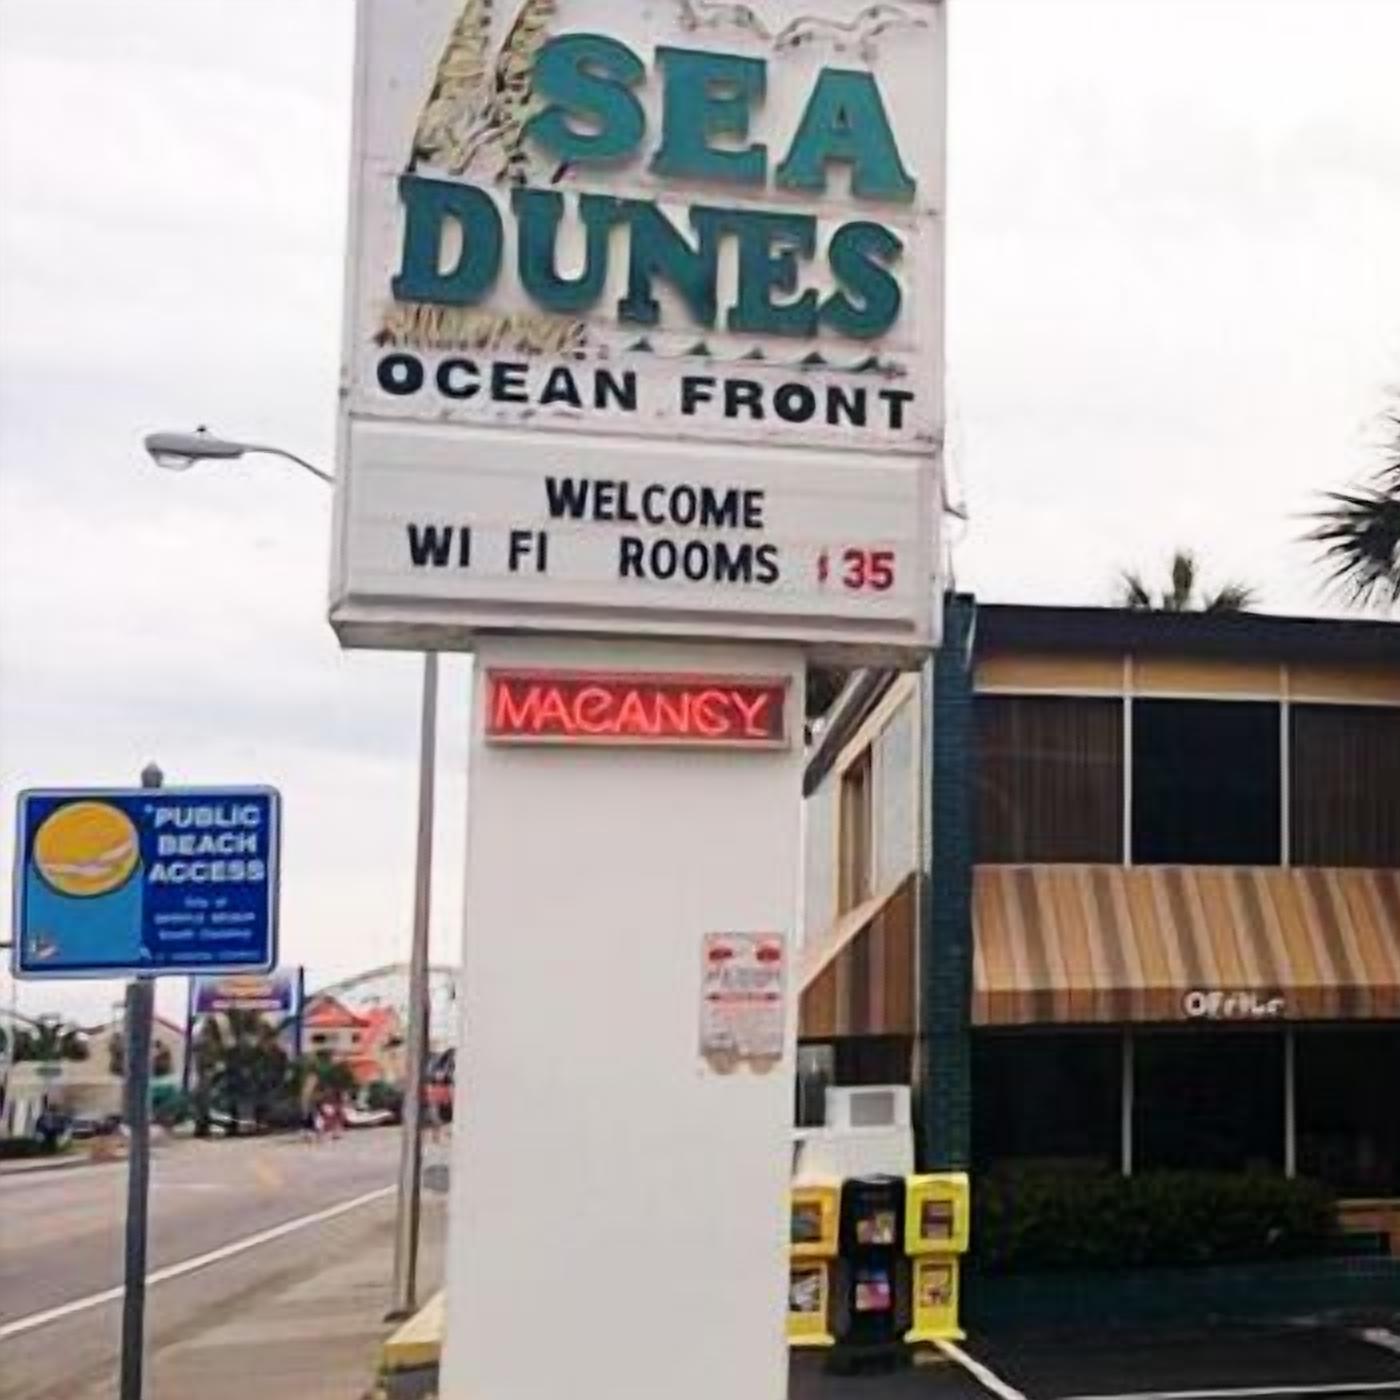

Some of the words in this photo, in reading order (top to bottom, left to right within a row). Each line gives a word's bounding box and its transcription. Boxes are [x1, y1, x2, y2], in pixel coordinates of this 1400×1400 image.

[525, 32, 916, 204] SEA
[391, 174, 904, 339] DUNES
[376, 353, 637, 411] OCEAN
[680, 377, 915, 430] FRONT
[544, 476, 765, 530] WELCOME
[406, 523, 471, 568] WI
[508, 530, 548, 572] FI
[618, 536, 780, 584] ROOMS
[154, 805, 261, 828] PUBLIC
[157, 832, 258, 856] BEACH
[149, 860, 265, 882] ACCESS
